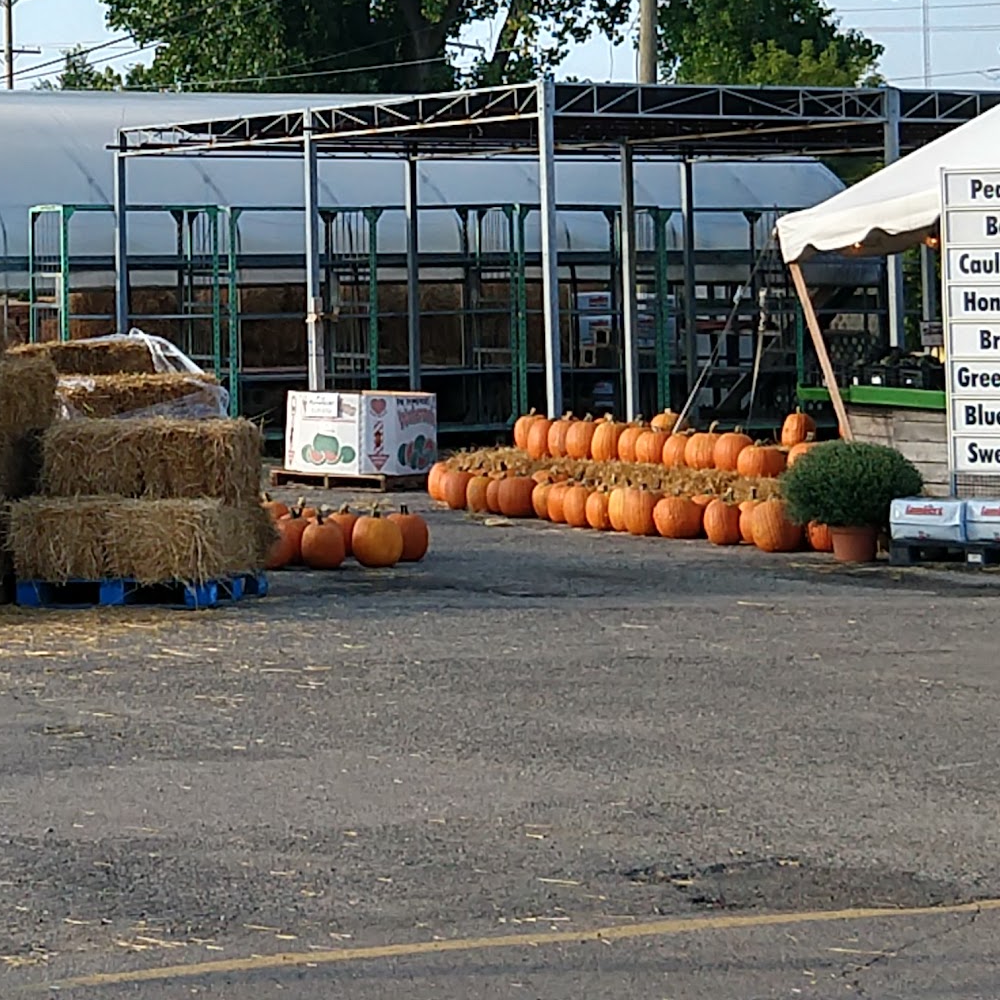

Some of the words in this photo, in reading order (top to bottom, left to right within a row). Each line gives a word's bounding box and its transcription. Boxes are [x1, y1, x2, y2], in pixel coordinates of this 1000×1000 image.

[986, 216, 1000, 236] B
[959, 252, 1000, 274] Caul
[964, 291, 1000, 311] Hon
[980, 329, 1000, 349] Br
[958, 367, 1000, 387] Gree
